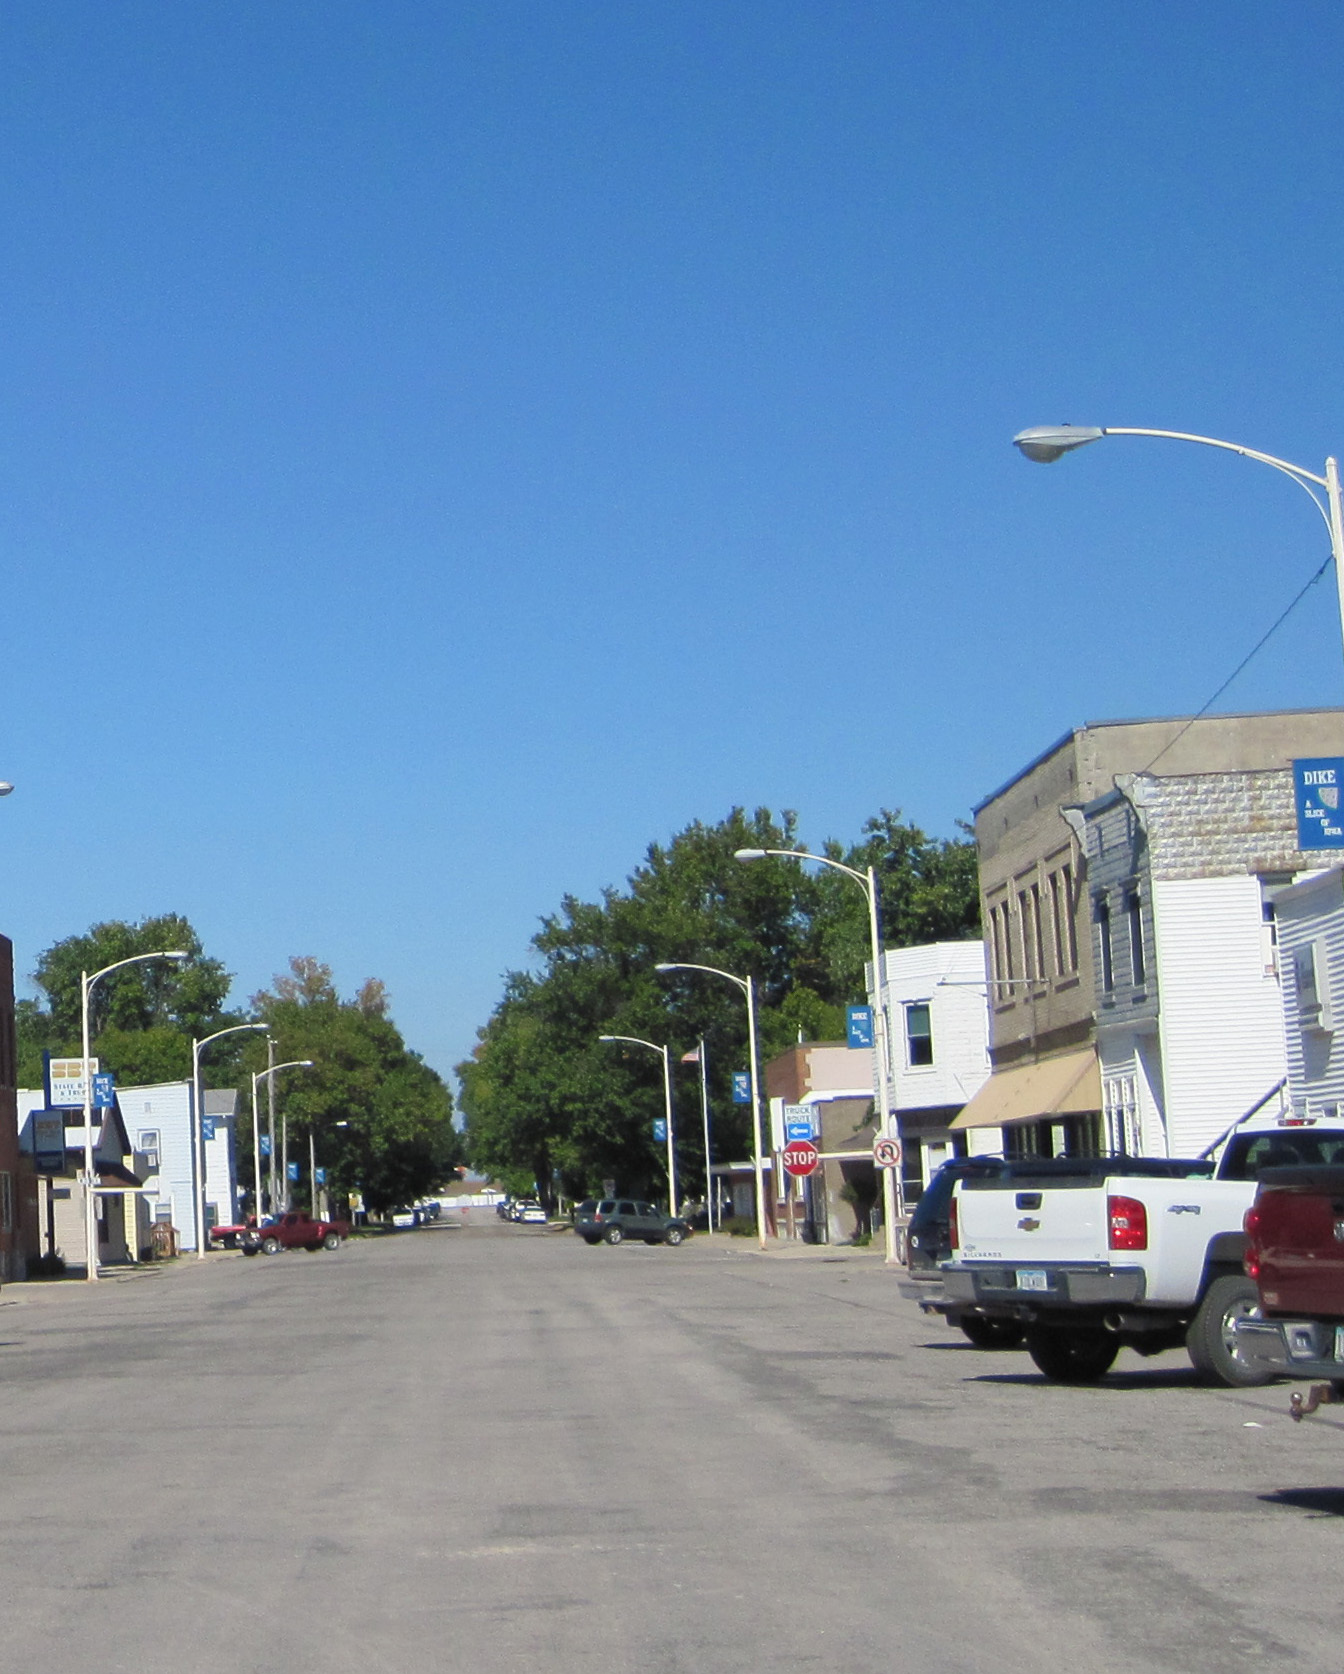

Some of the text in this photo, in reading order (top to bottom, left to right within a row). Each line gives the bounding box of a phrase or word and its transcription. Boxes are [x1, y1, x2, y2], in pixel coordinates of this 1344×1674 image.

[1303, 769, 1336, 785] DIKE
[1305, 800, 1312, 808] A
[784, 1151, 816, 1166] STOP
